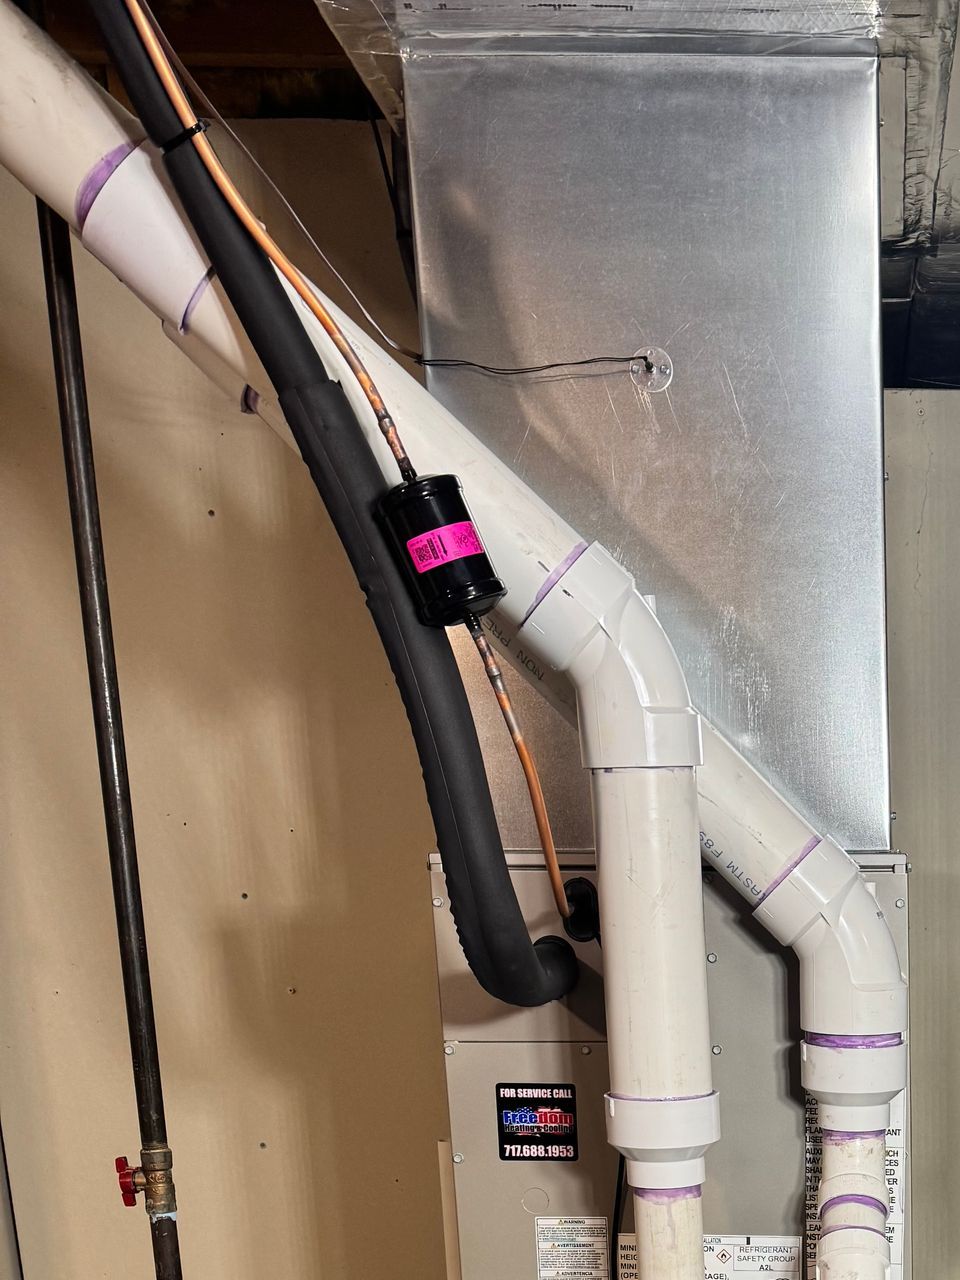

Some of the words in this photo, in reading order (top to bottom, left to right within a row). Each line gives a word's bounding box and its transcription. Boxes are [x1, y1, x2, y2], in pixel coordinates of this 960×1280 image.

[725, 860, 762, 896] ASTM
[500, 1088, 516, 1098] FOR
[517, 1088, 552, 1098] SERVICE
[553, 1089, 573, 1099] CALL
[502, 1110, 574, 1125] Freedom
[504, 1124, 536, 1133] Heating
[503, 1144, 574, 1157] 717.688.1953
[739, 1246, 792, 1254] REFRIGERANT
